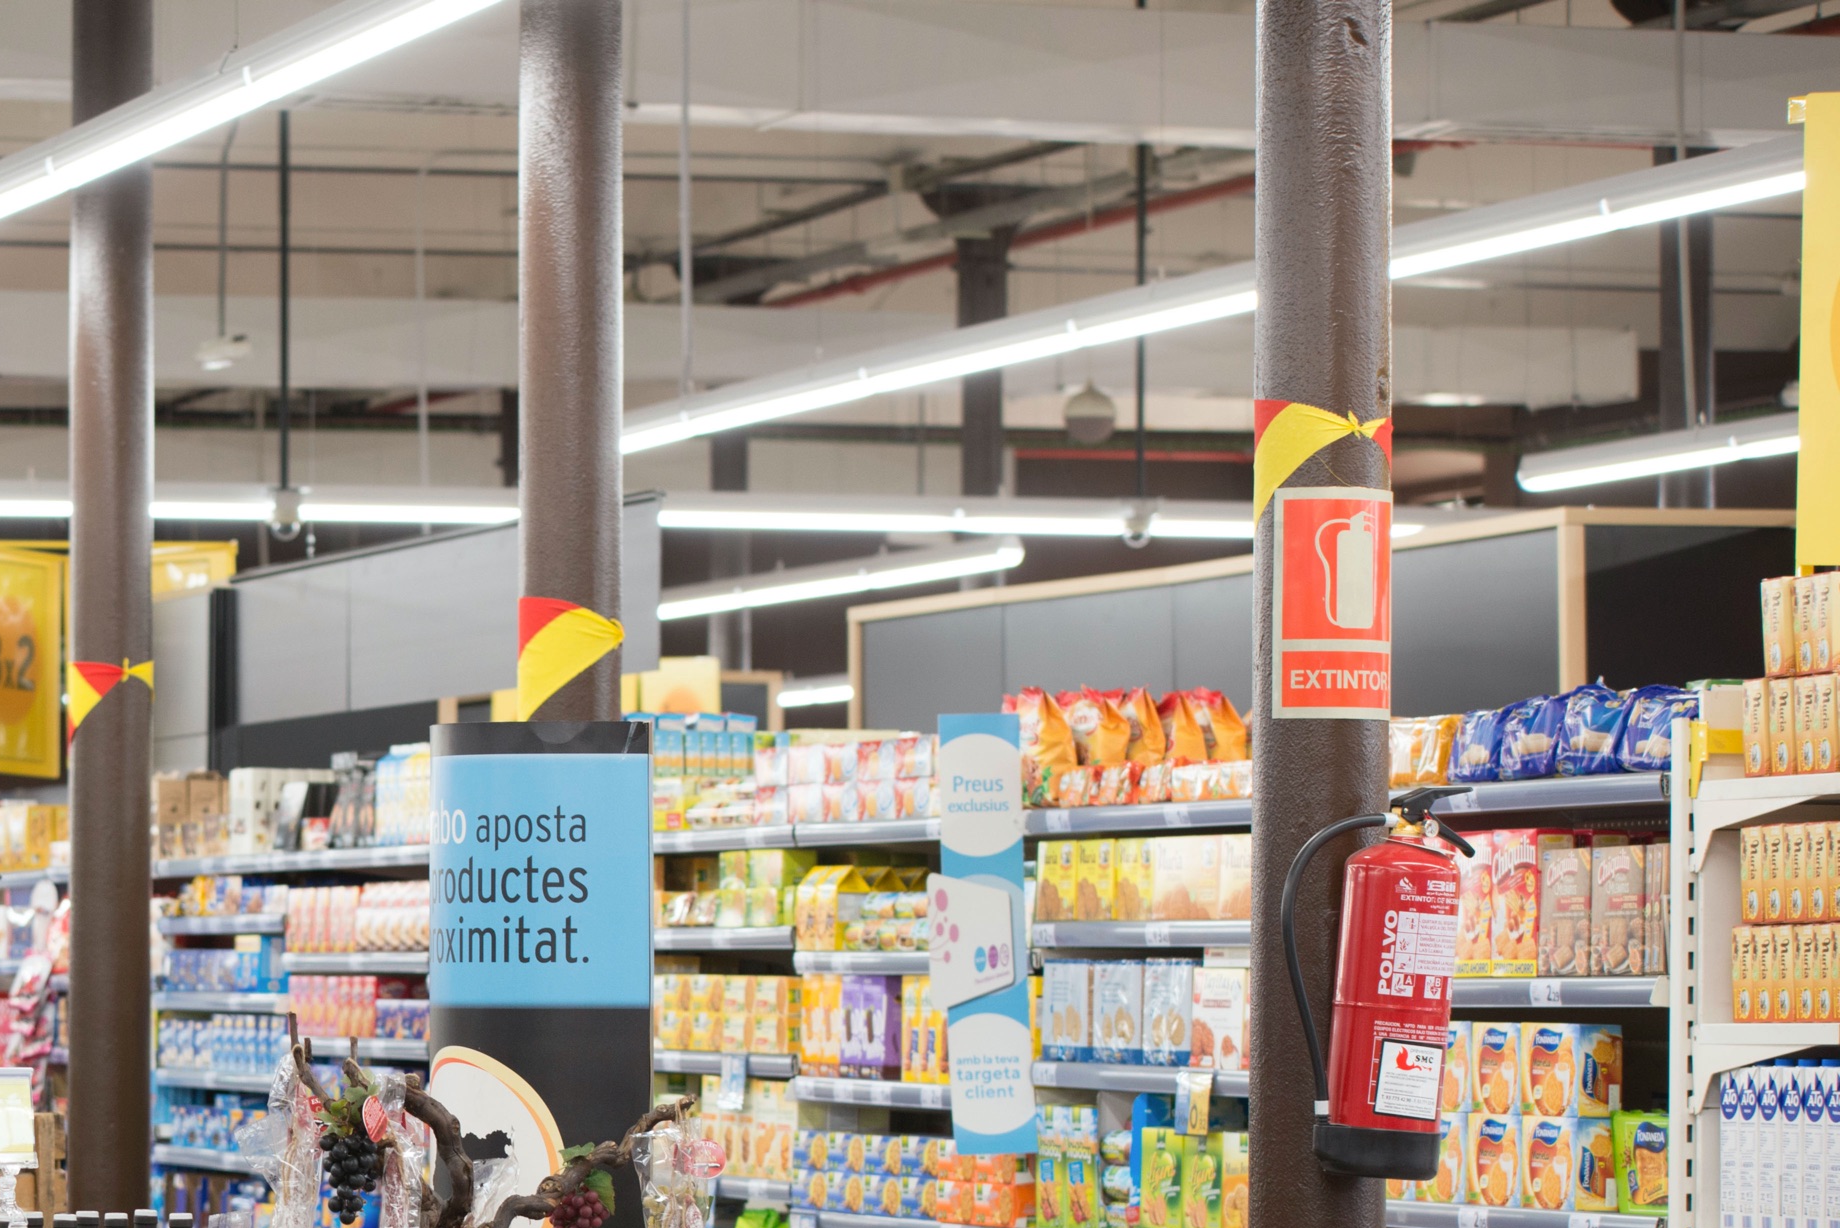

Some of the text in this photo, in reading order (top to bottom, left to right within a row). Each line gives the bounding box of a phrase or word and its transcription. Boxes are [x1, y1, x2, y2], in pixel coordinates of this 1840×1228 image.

[1290, 669, 1389, 690] EXTINTOR
[953, 775, 1004, 792] Preus
[947, 798, 1009, 812] exclusius
[476, 804, 587, 851] aposta
[431, 855, 589, 914] productes
[1377, 910, 1398, 996] POLVO
[983, 1054, 993, 1064] la
[995, 1056, 1020, 1064] teva
[1415, 1055, 1434, 1064] SMC
[957, 1067, 1020, 1083] targeta
[965, 1085, 1014, 1099] client
[1722, 1089, 1737, 1105] ATO
[1741, 1089, 1756, 1106] ATO
[1761, 1089, 1776, 1106] ATO
[1784, 1090, 1800, 1107] ATO
[1807, 1090, 1824, 1107] ATO
[1636, 1130, 1665, 1143] FONTANEDA
